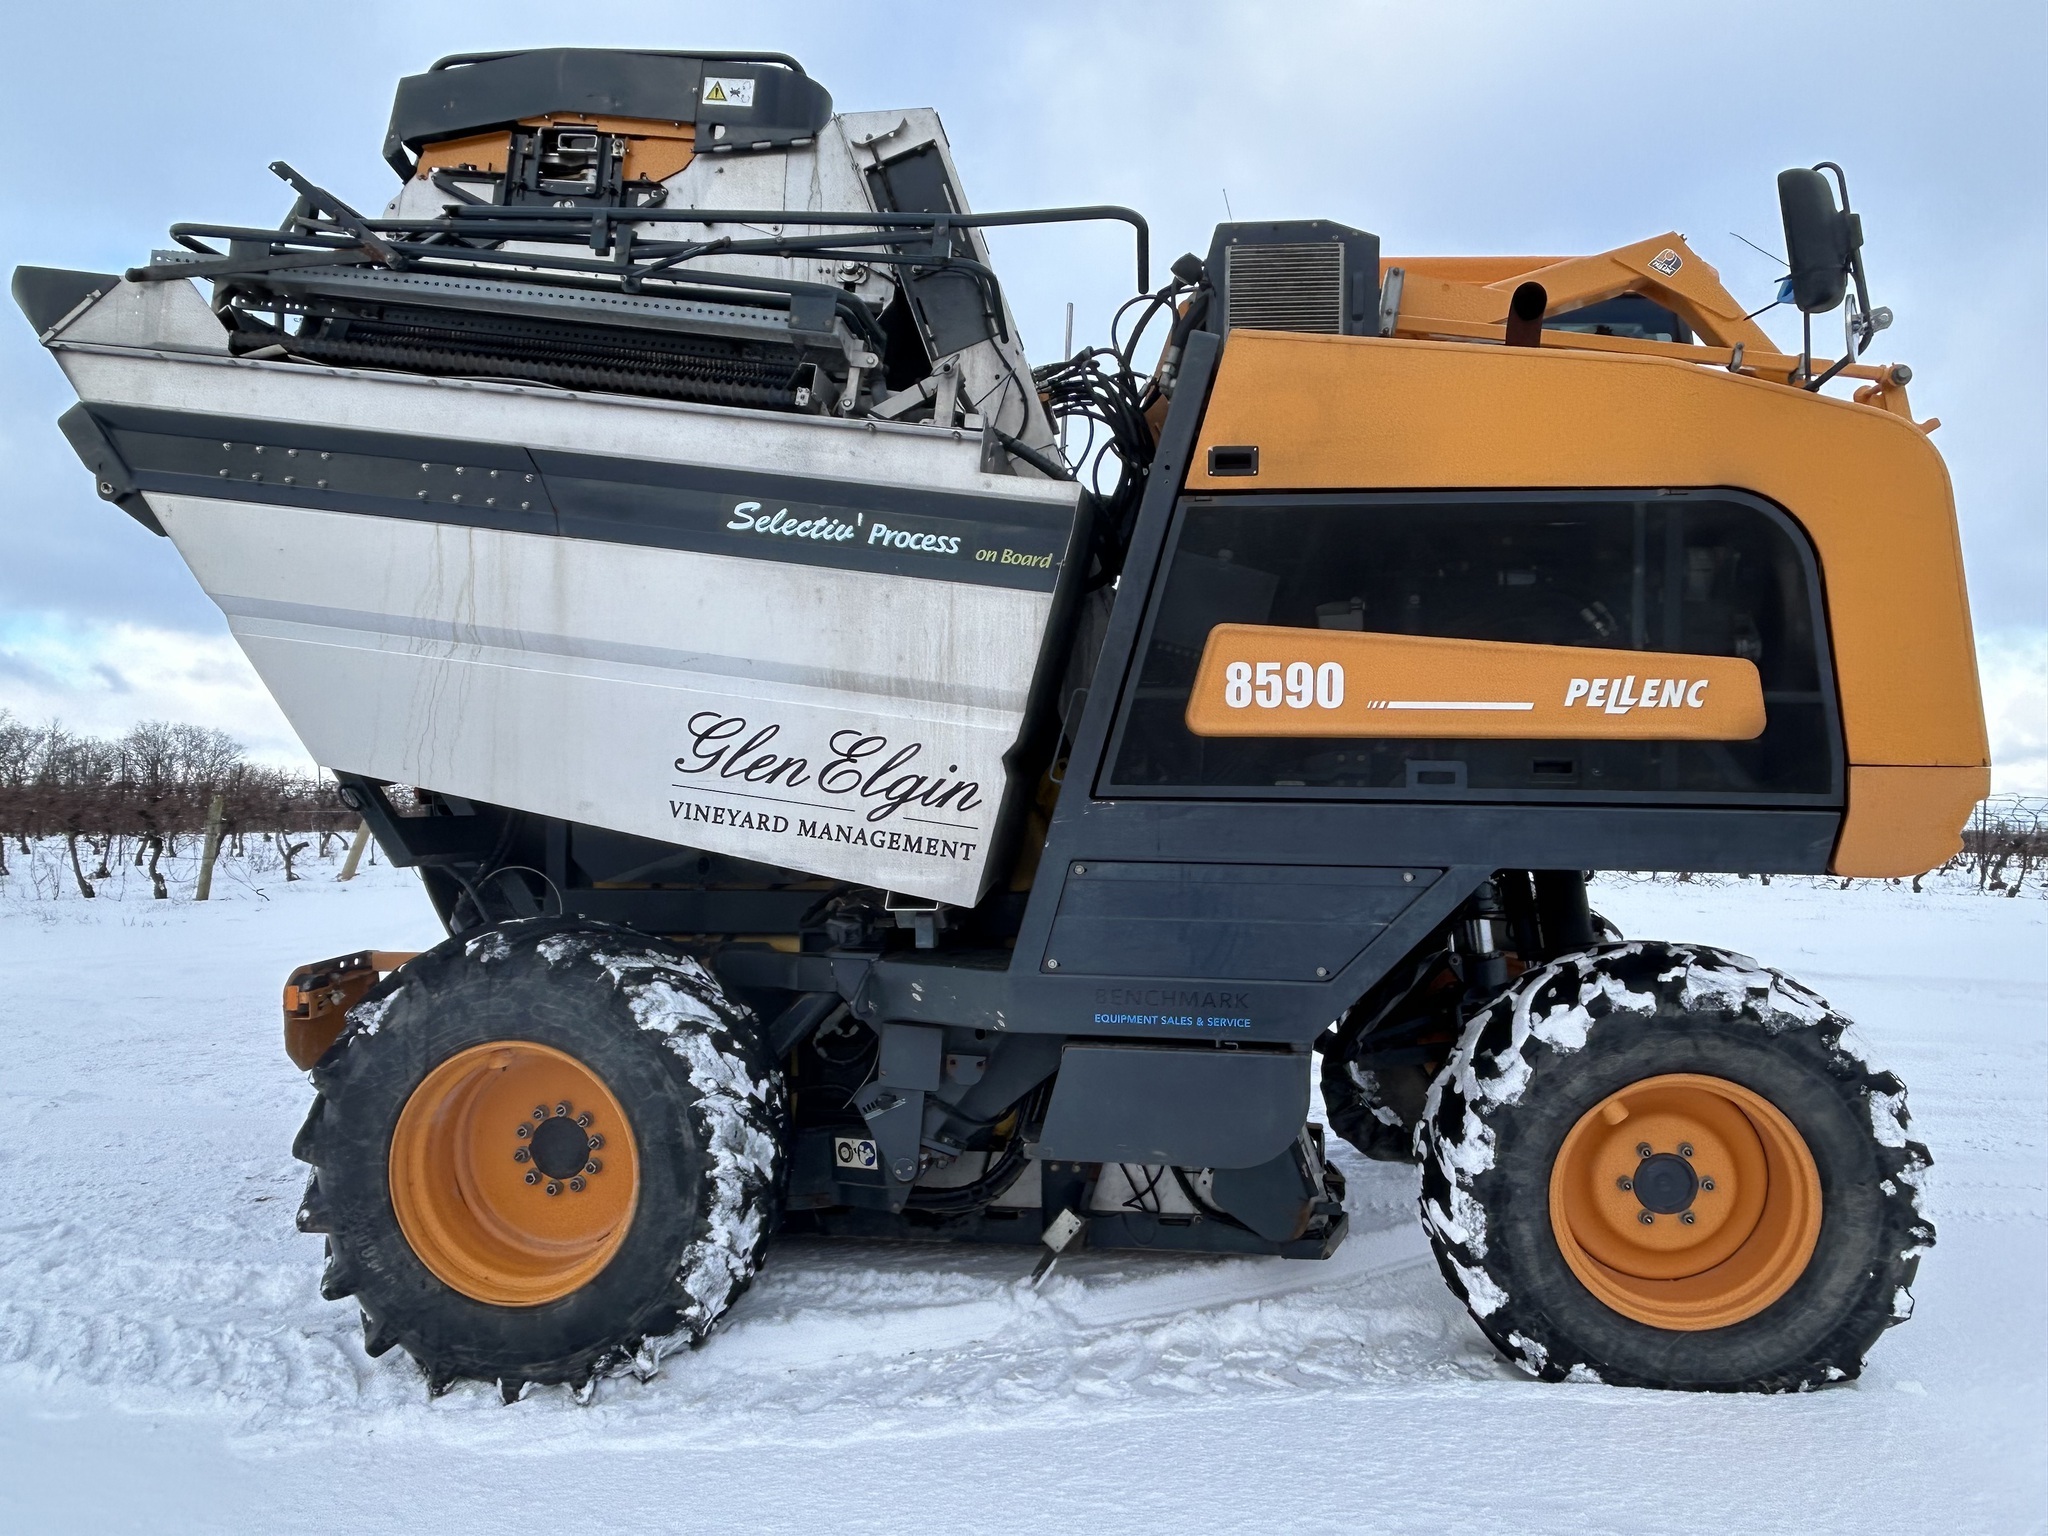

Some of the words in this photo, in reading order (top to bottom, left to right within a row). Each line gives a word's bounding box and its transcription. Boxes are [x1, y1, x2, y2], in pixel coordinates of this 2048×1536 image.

[867, 523, 962, 554] Process
[975, 548, 997, 563] on
[1000, 549, 1054, 569] Board
[1224, 661, 1345, 709] 8590
[1564, 675, 1710, 714] PELLENC
[674, 711, 811, 788] Glen
[818, 729, 983, 822] Elgin
[669, 800, 789, 834] VINEYARD
[796, 819, 978, 861] MANAGEMENT
[1094, 1013, 1159, 1025] EQUIPMENT
[1160, 1015, 1193, 1026] SALES
[1196, 1016, 1204, 1027] &
[1207, 1017, 1251, 1028] SERVICE
[1095, 988, 1250, 1009] BENCHMARK
